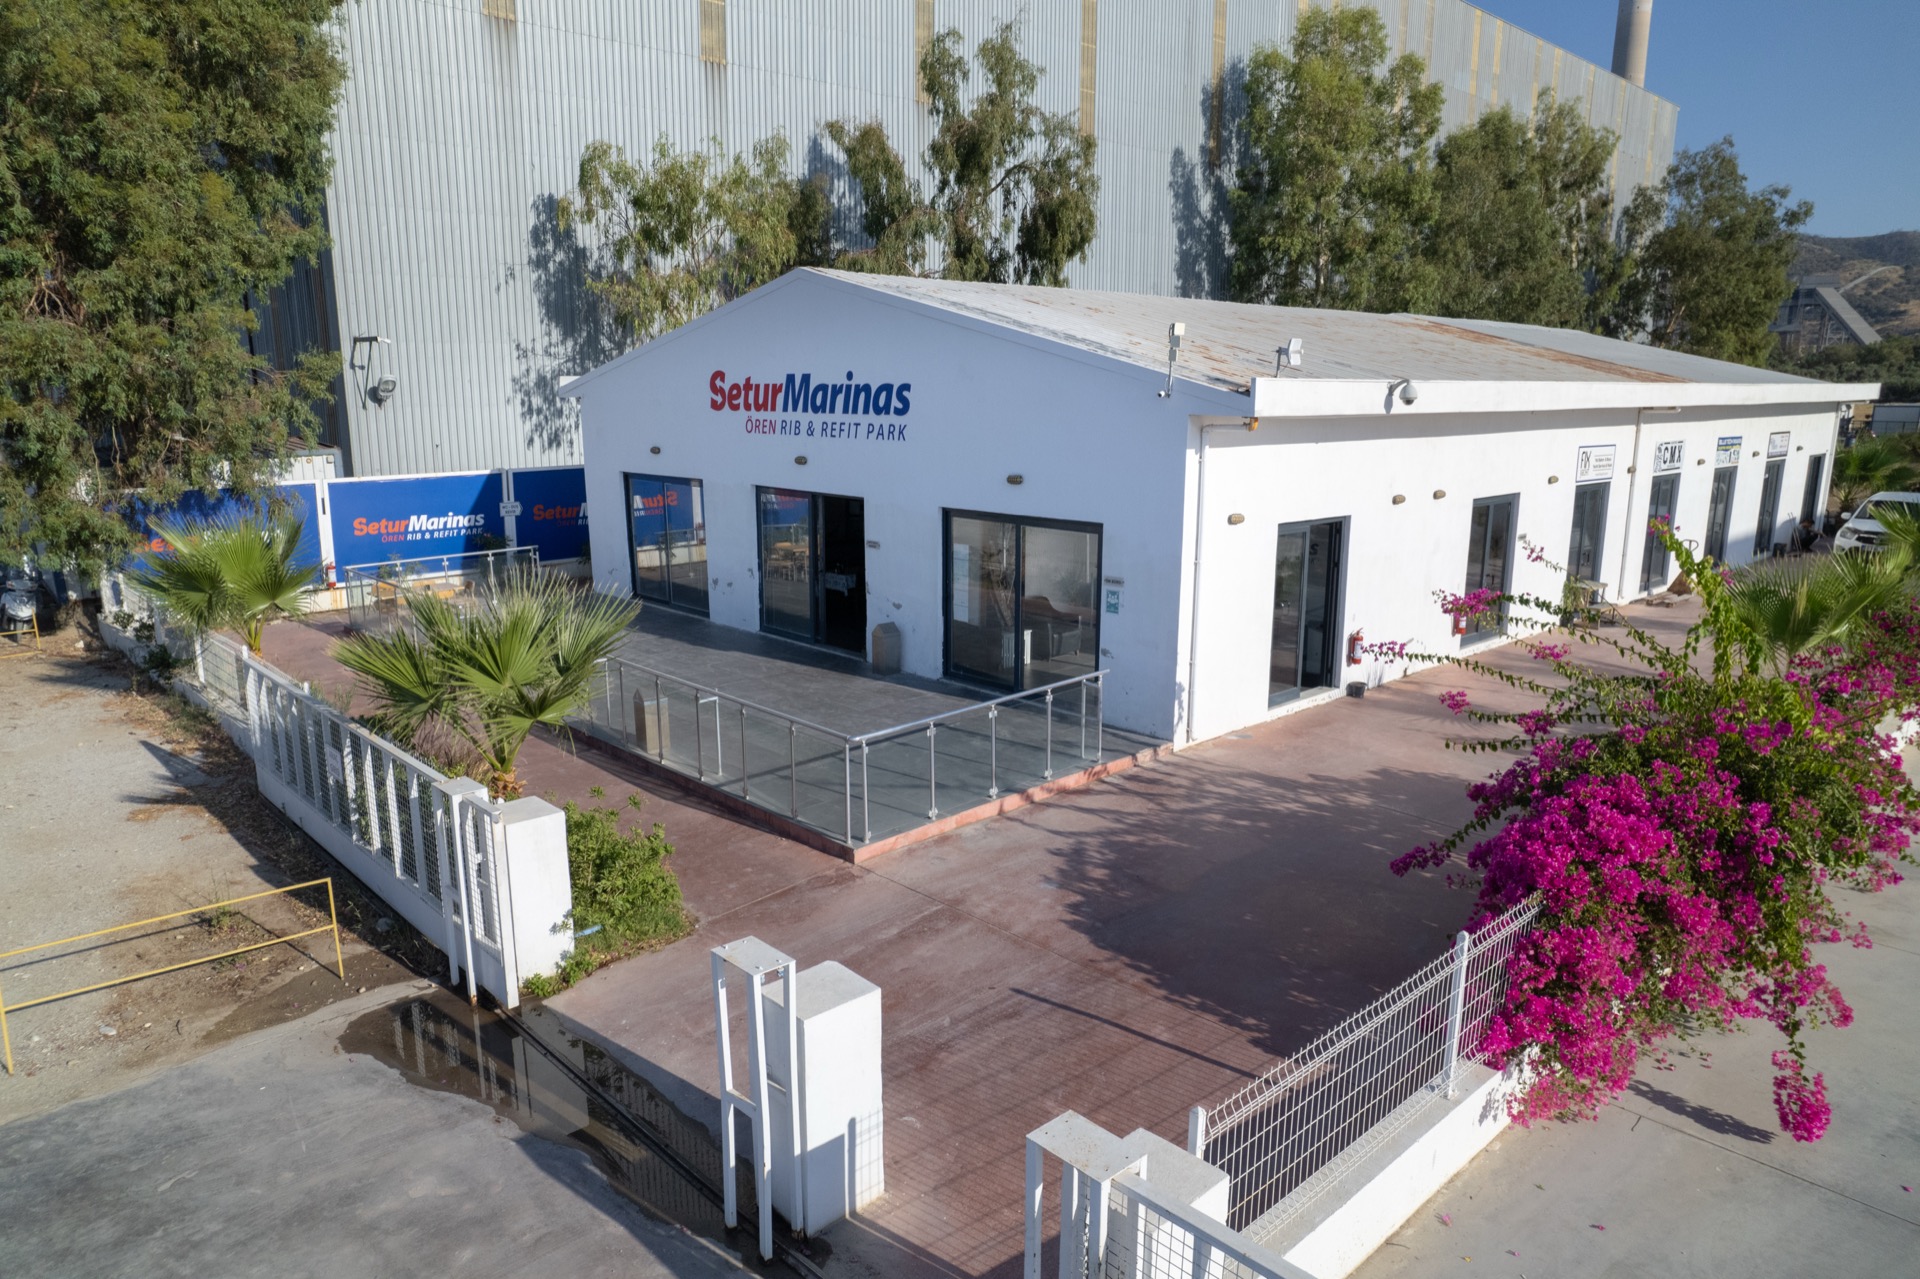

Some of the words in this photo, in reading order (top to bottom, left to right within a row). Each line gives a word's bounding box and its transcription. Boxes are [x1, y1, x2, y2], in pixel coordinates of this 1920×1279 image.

[709, 369, 912, 417] SeturMarinas
[745, 415, 777, 435] ÖREN
[780, 419, 801, 436] RIB
[806, 420, 815, 437] &
[820, 421, 861, 439] REFIT
[866, 422, 907, 441] PARK
[1663, 444, 1683, 465] CMX
[353, 511, 485, 536] SeturMarinas
[407, 532, 422, 541] RIB
[424, 531, 431, 539] &
[433, 529, 459, 538] REFIT
[460, 527, 482, 536] PARK
